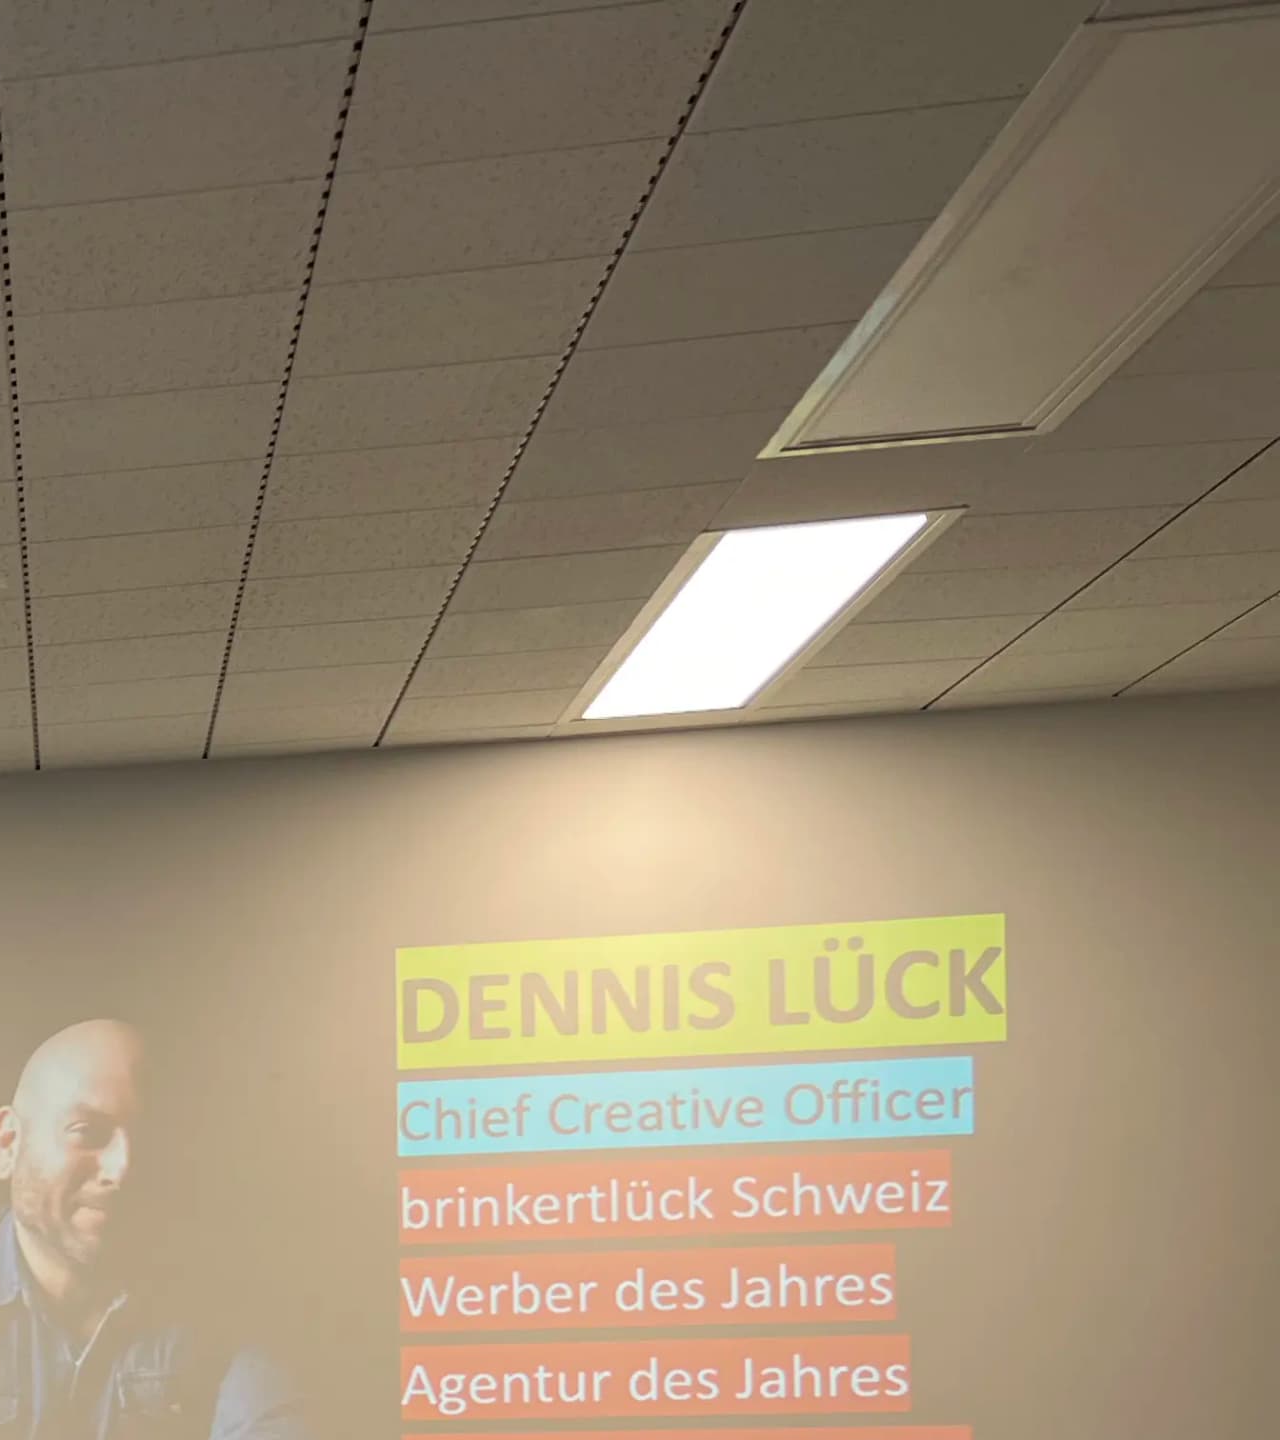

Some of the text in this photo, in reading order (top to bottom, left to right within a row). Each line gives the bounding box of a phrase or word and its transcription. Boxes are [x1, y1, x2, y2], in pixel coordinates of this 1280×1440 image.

[402, 936, 1005, 1043] DENNIS LÜCK
[399, 1078, 973, 1141] Chief Creative Officer
[401, 1170, 950, 1230] brinkertlück Schweiz
[401, 1264, 894, 1317] Werber des Jahres
[401, 1354, 909, 1415] Agentur des Jahres
